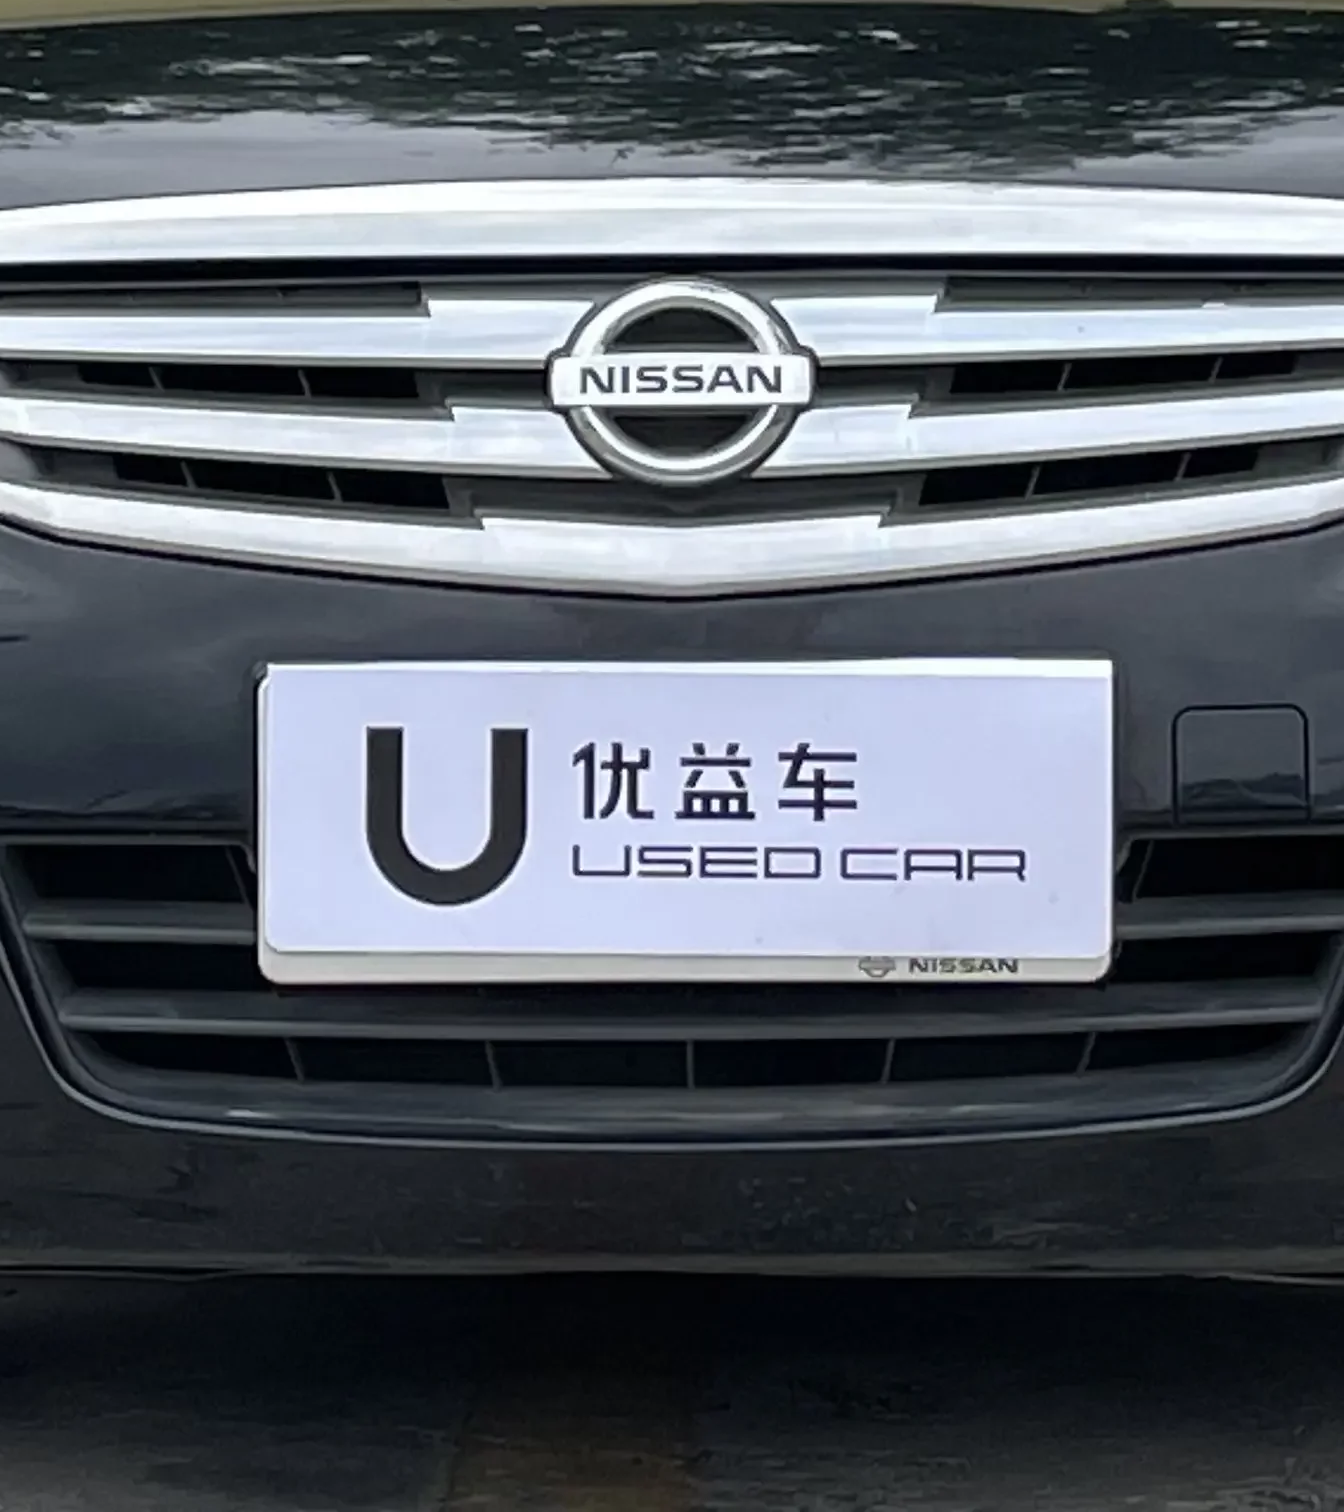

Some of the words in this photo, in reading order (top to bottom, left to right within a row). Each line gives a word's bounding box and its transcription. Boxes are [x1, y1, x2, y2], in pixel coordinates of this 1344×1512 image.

[579, 364, 782, 394] NISSAN
[572, 742, 858, 822] 优益车
[366, 726, 529, 907] U
[572, 844, 822, 879] USED
[839, 848, 1027, 882] CAR
[908, 957, 1020, 974] NISSAN
